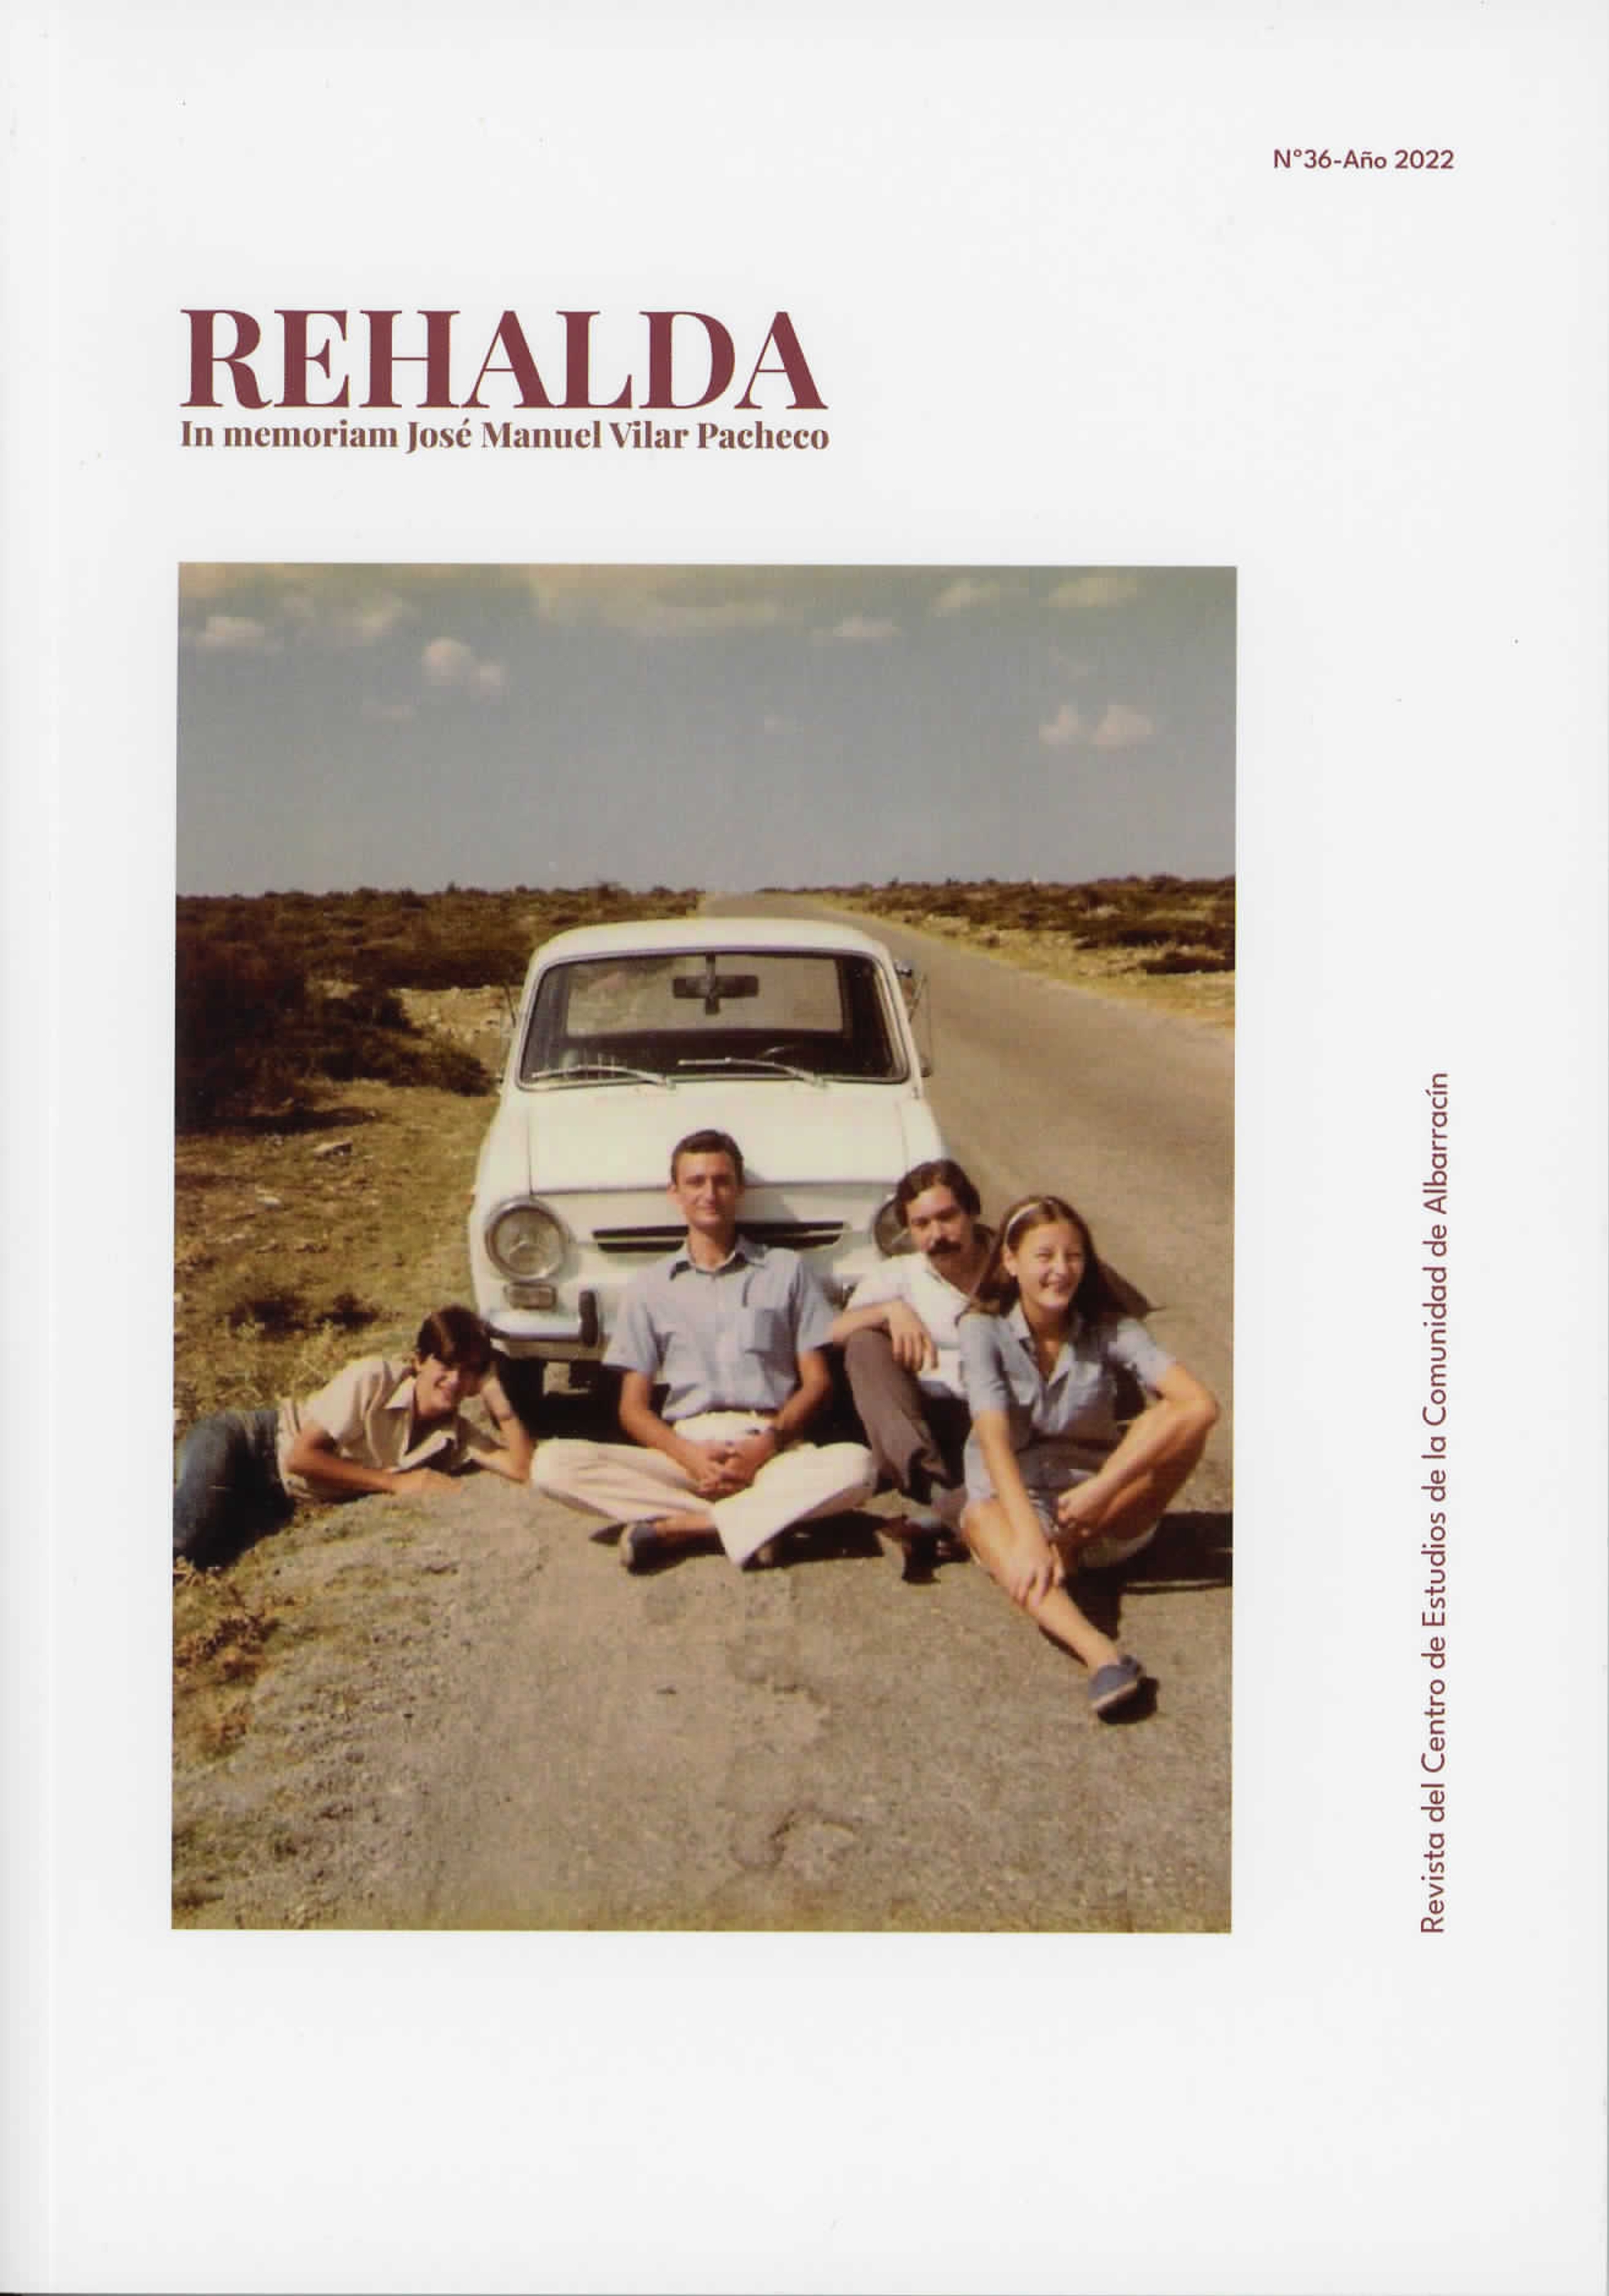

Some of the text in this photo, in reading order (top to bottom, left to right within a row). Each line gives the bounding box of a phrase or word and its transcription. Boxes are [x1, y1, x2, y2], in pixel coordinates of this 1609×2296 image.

[1274, 149, 1454, 169] N°36-Año 2022
[180, 309, 828, 410] REHALDA
[181, 418, 829, 454] In memoriam José Manuel Vilar Pacheco
[1420, 1074, 1448, 1933] Revista del Centro de Estudios de la Comunidad de Albarracín
